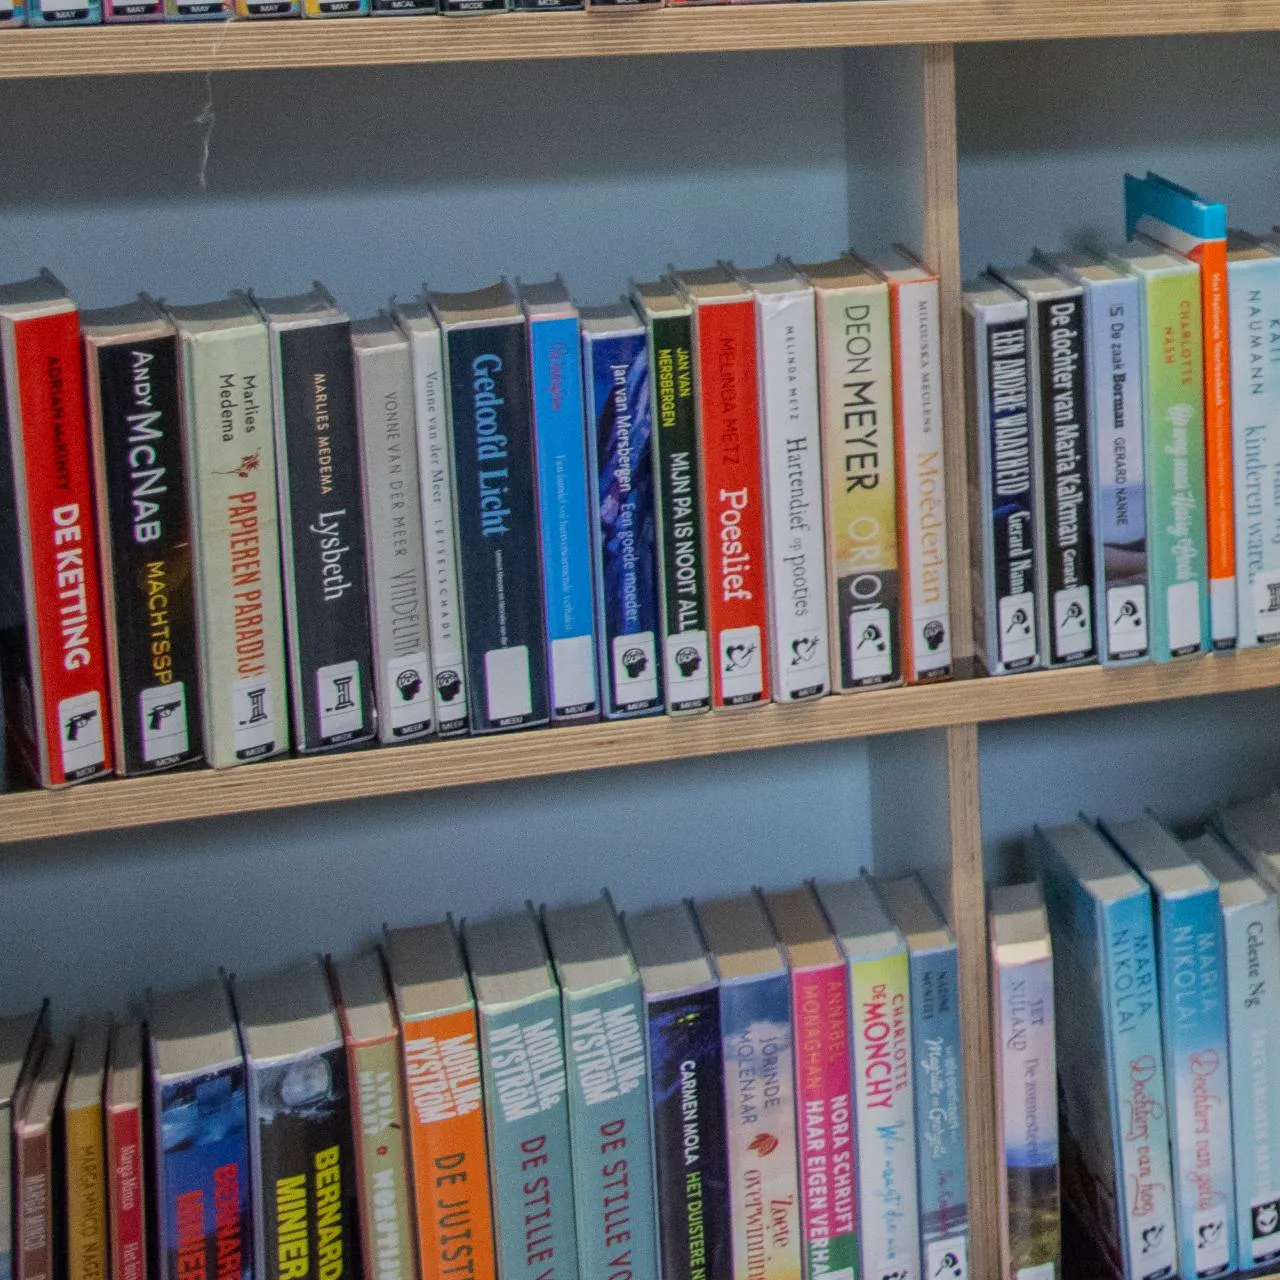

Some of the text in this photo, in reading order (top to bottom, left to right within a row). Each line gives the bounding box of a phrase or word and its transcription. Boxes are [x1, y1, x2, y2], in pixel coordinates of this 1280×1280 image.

[842, 304, 879, 495] DEON MEYER
[1248, 290, 1265, 395] NAUMANN
[127, 349, 169, 543] ANDY McNAB
[219, 374, 234, 442] Medema
[244, 375, 257, 434] Marlies
[470, 353, 512, 537] Gedoofd Licht
[1050, 303, 1080, 546] De dochter van Maria Kalkman
[228, 491, 261, 584] PAPIEREN
[310, 508, 351, 602] Lysbeth
[670, 452, 696, 596] MIJN PA IS NOOIT
[718, 488, 753, 603] Poeslief
[53, 503, 91, 673] DE KETTING
[1246, 922, 1264, 1009] Celeste Ng
[679, 1060, 699, 1165] CARMEN MOLA
[863, 1000, 893, 1110] MONCHY
[520, 1136, 554, 1257] DE STILLE
[601, 1120, 631, 1245] DE STILLE
[805, 1100, 826, 1203] HAAR EIGEN
[314, 1145, 344, 1280] BERNARD
